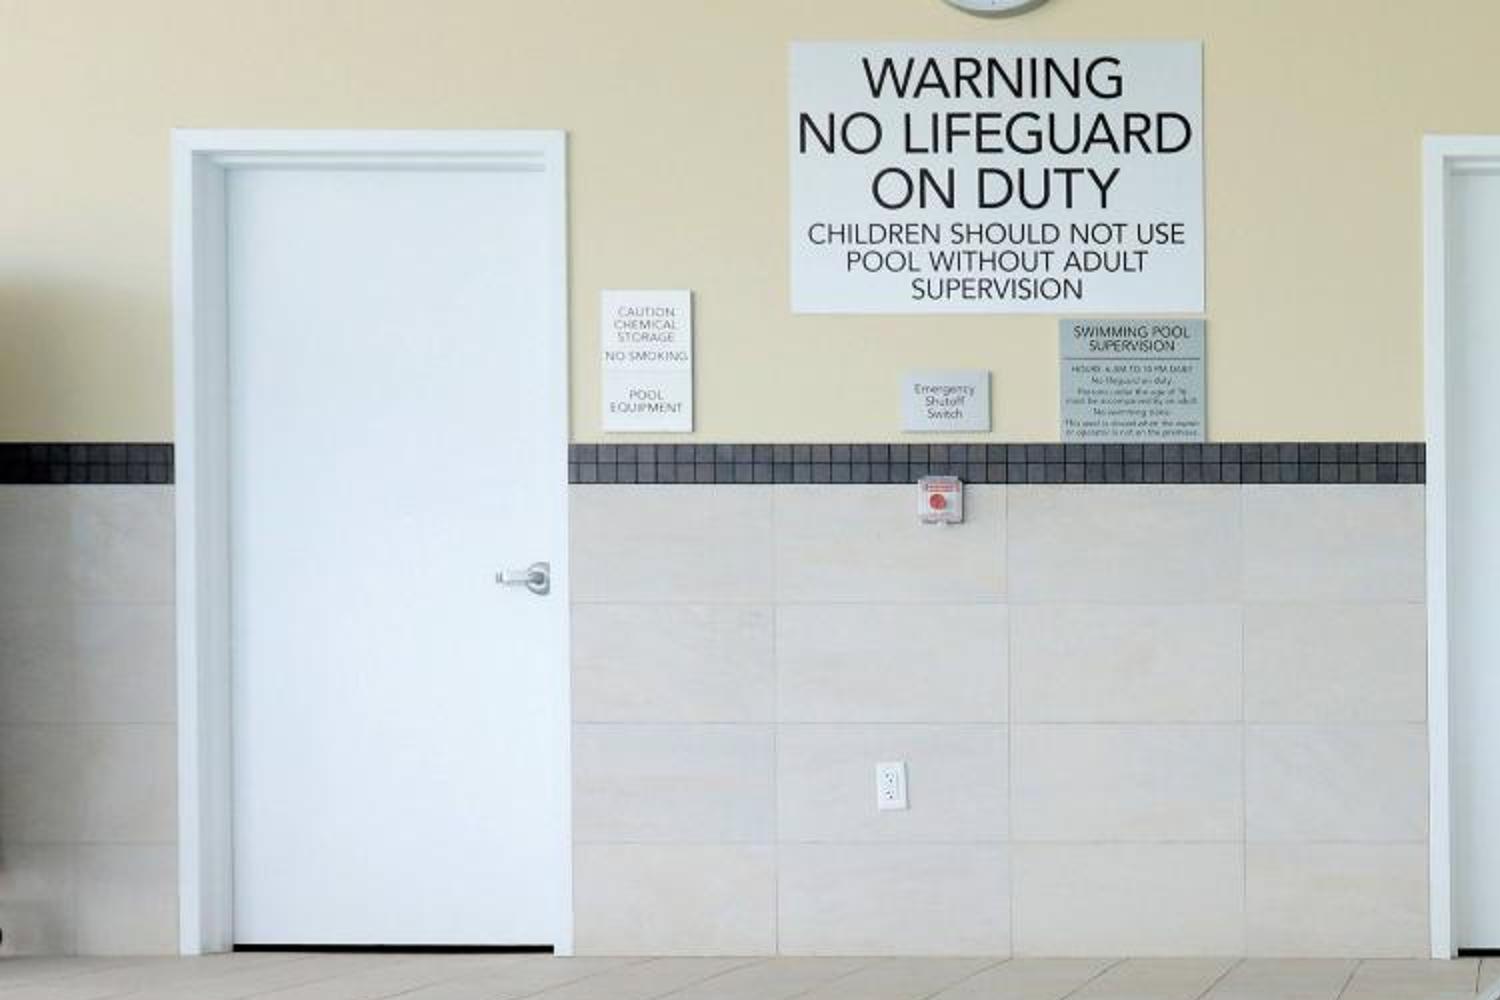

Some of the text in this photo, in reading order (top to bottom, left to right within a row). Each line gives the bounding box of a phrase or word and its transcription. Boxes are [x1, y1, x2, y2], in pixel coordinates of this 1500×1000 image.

[863, 57, 1122, 99] WARNING
[800, 112, 1192, 154] NO LIFEGUARD
[872, 168, 1120, 209] ON DUTY
[808, 223, 1184, 244] CHILDREN SHOULD NOT USE
[848, 250, 1148, 272] POOL WITHOUT ADULT
[912, 278, 1082, 300] SUPERVISION
[618, 307, 675, 317] CAUTION
[614, 320, 675, 330] CHEMICAL
[618, 332, 673, 342] STORAGE
[1074, 325, 1189, 339] SWIMMING POOL
[1090, 340, 1175, 352] SUPERVISION
[606, 351, 688, 361] NO SMOKING
[629, 389, 664, 400] POOL
[915, 384, 974, 397] Emergency
[611, 402, 681, 412] EQUIPMENT
[926, 396, 965, 406] Shutoff
[928, 409, 962, 418] Switch
